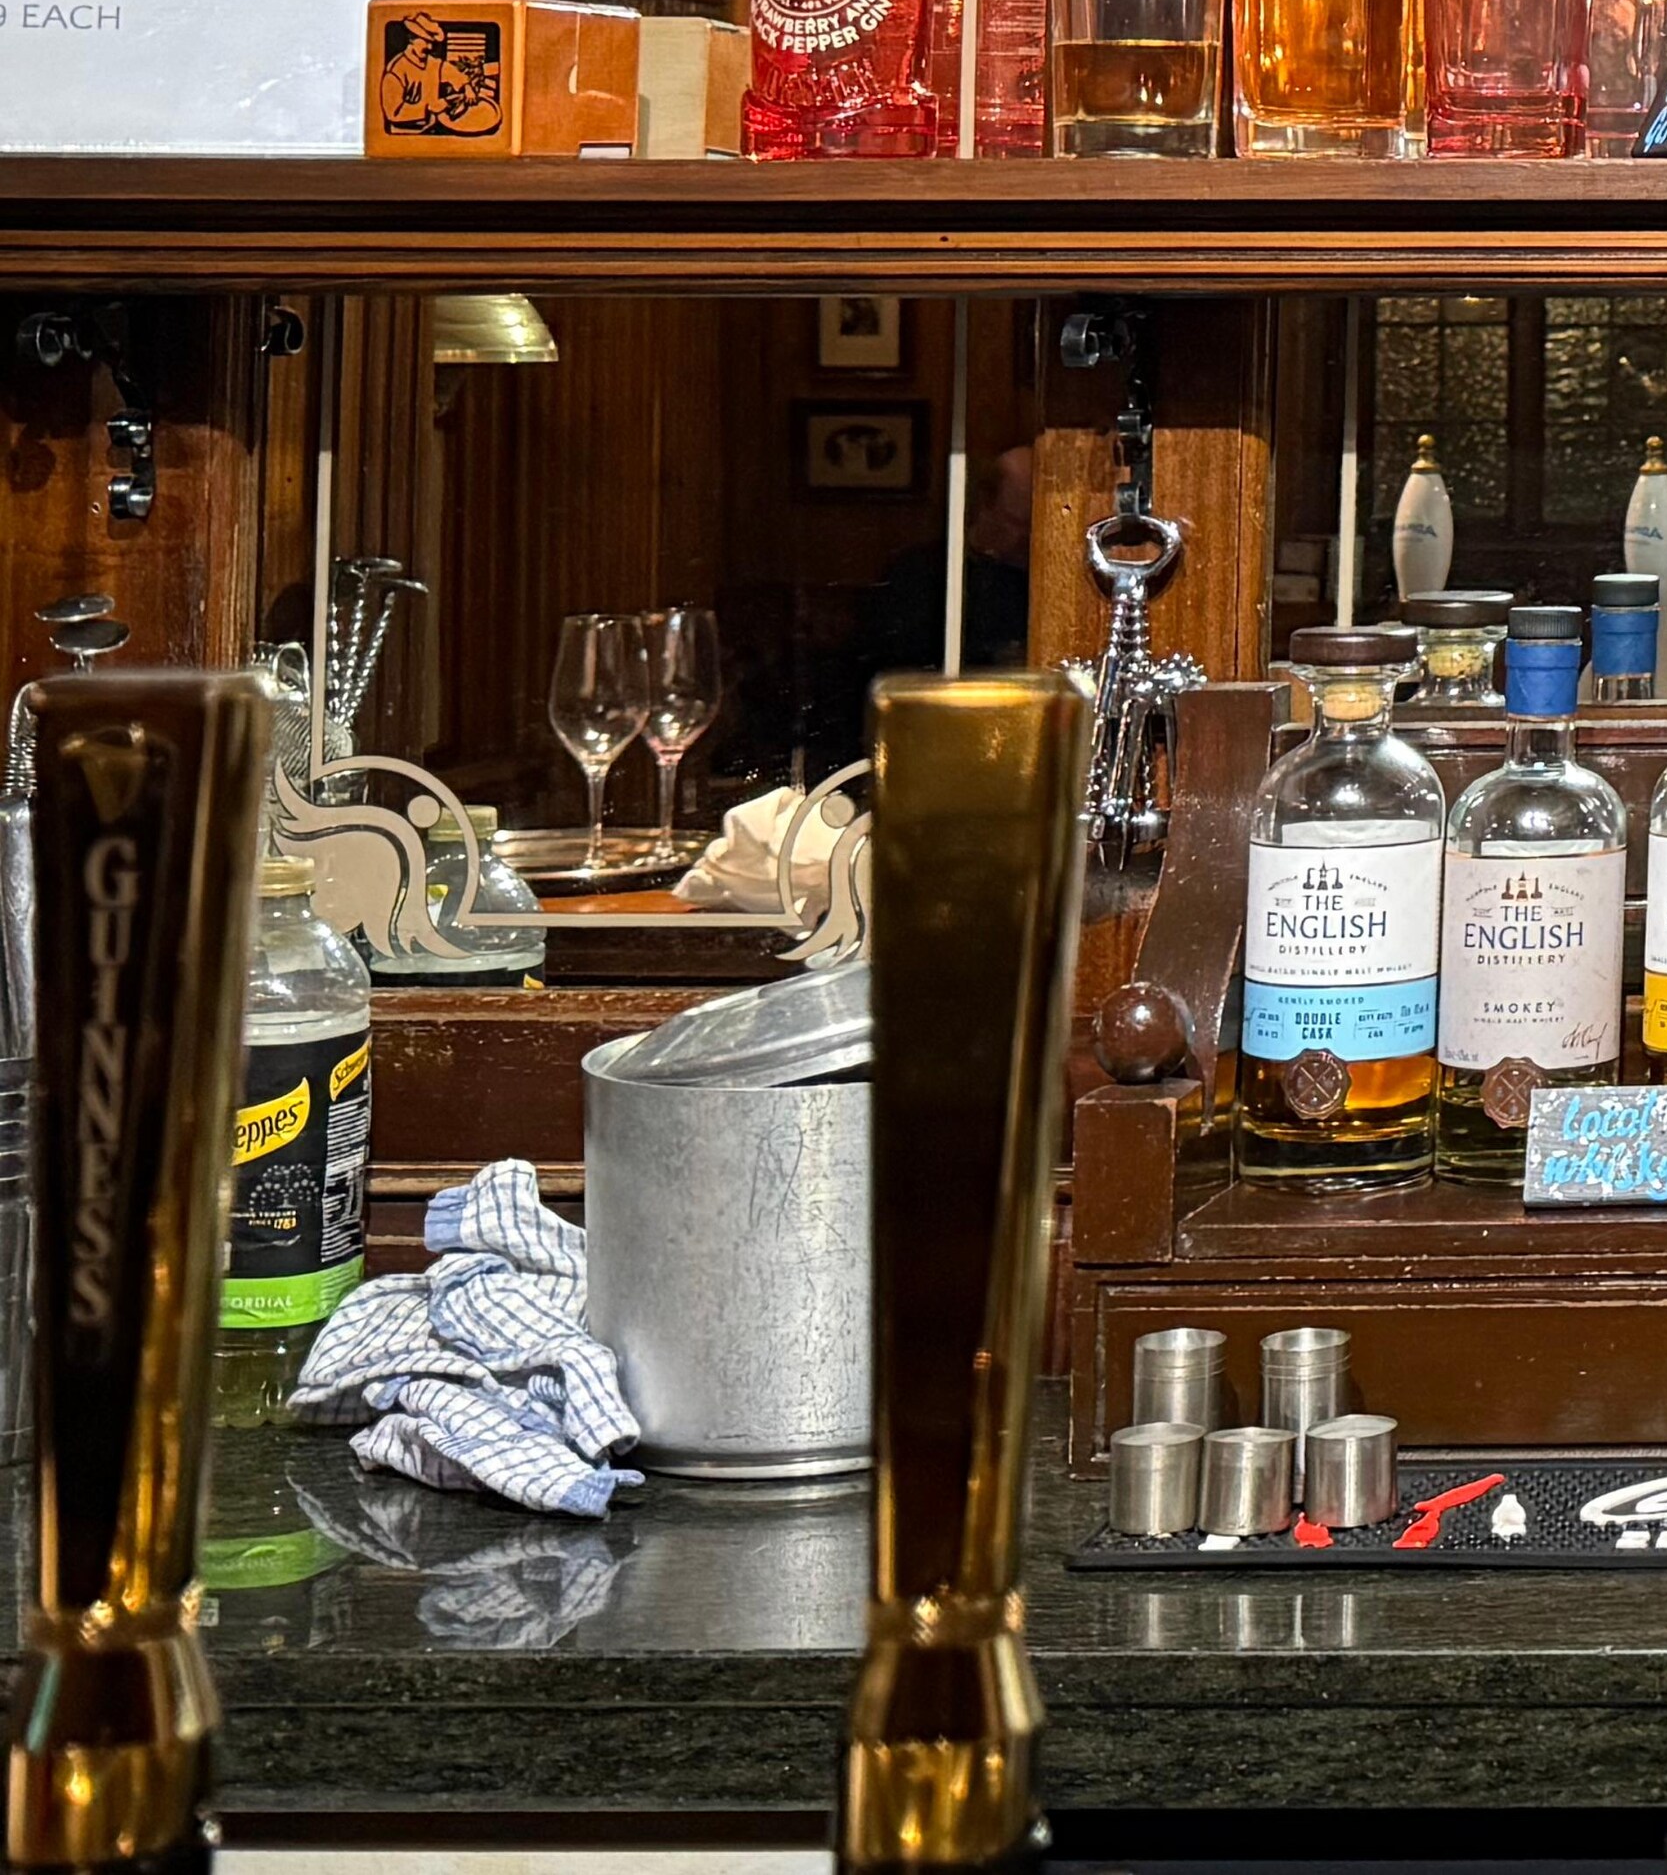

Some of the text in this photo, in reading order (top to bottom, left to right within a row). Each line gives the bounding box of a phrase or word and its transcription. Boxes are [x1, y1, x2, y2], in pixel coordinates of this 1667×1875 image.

[22, 4, 121, 30] EACH
[782, 26, 860, 54] PEPPER
[1302, 895, 1343, 911] THE
[1501, 905, 1543, 922] THE
[1266, 911, 1387, 939] ENGLISH
[1464, 922, 1583, 950] ENGLISH
[1279, 945, 1367, 956] DISTILLERY
[1477, 954, 1566, 965] DISTILLERY
[1484, 1002, 1555, 1014] SMOKEY
[1295, 1012, 1341, 1025] DOUBLE
[1302, 1027, 1333, 1040] CASK
[70, 837, 139, 1325] GUINNESS
